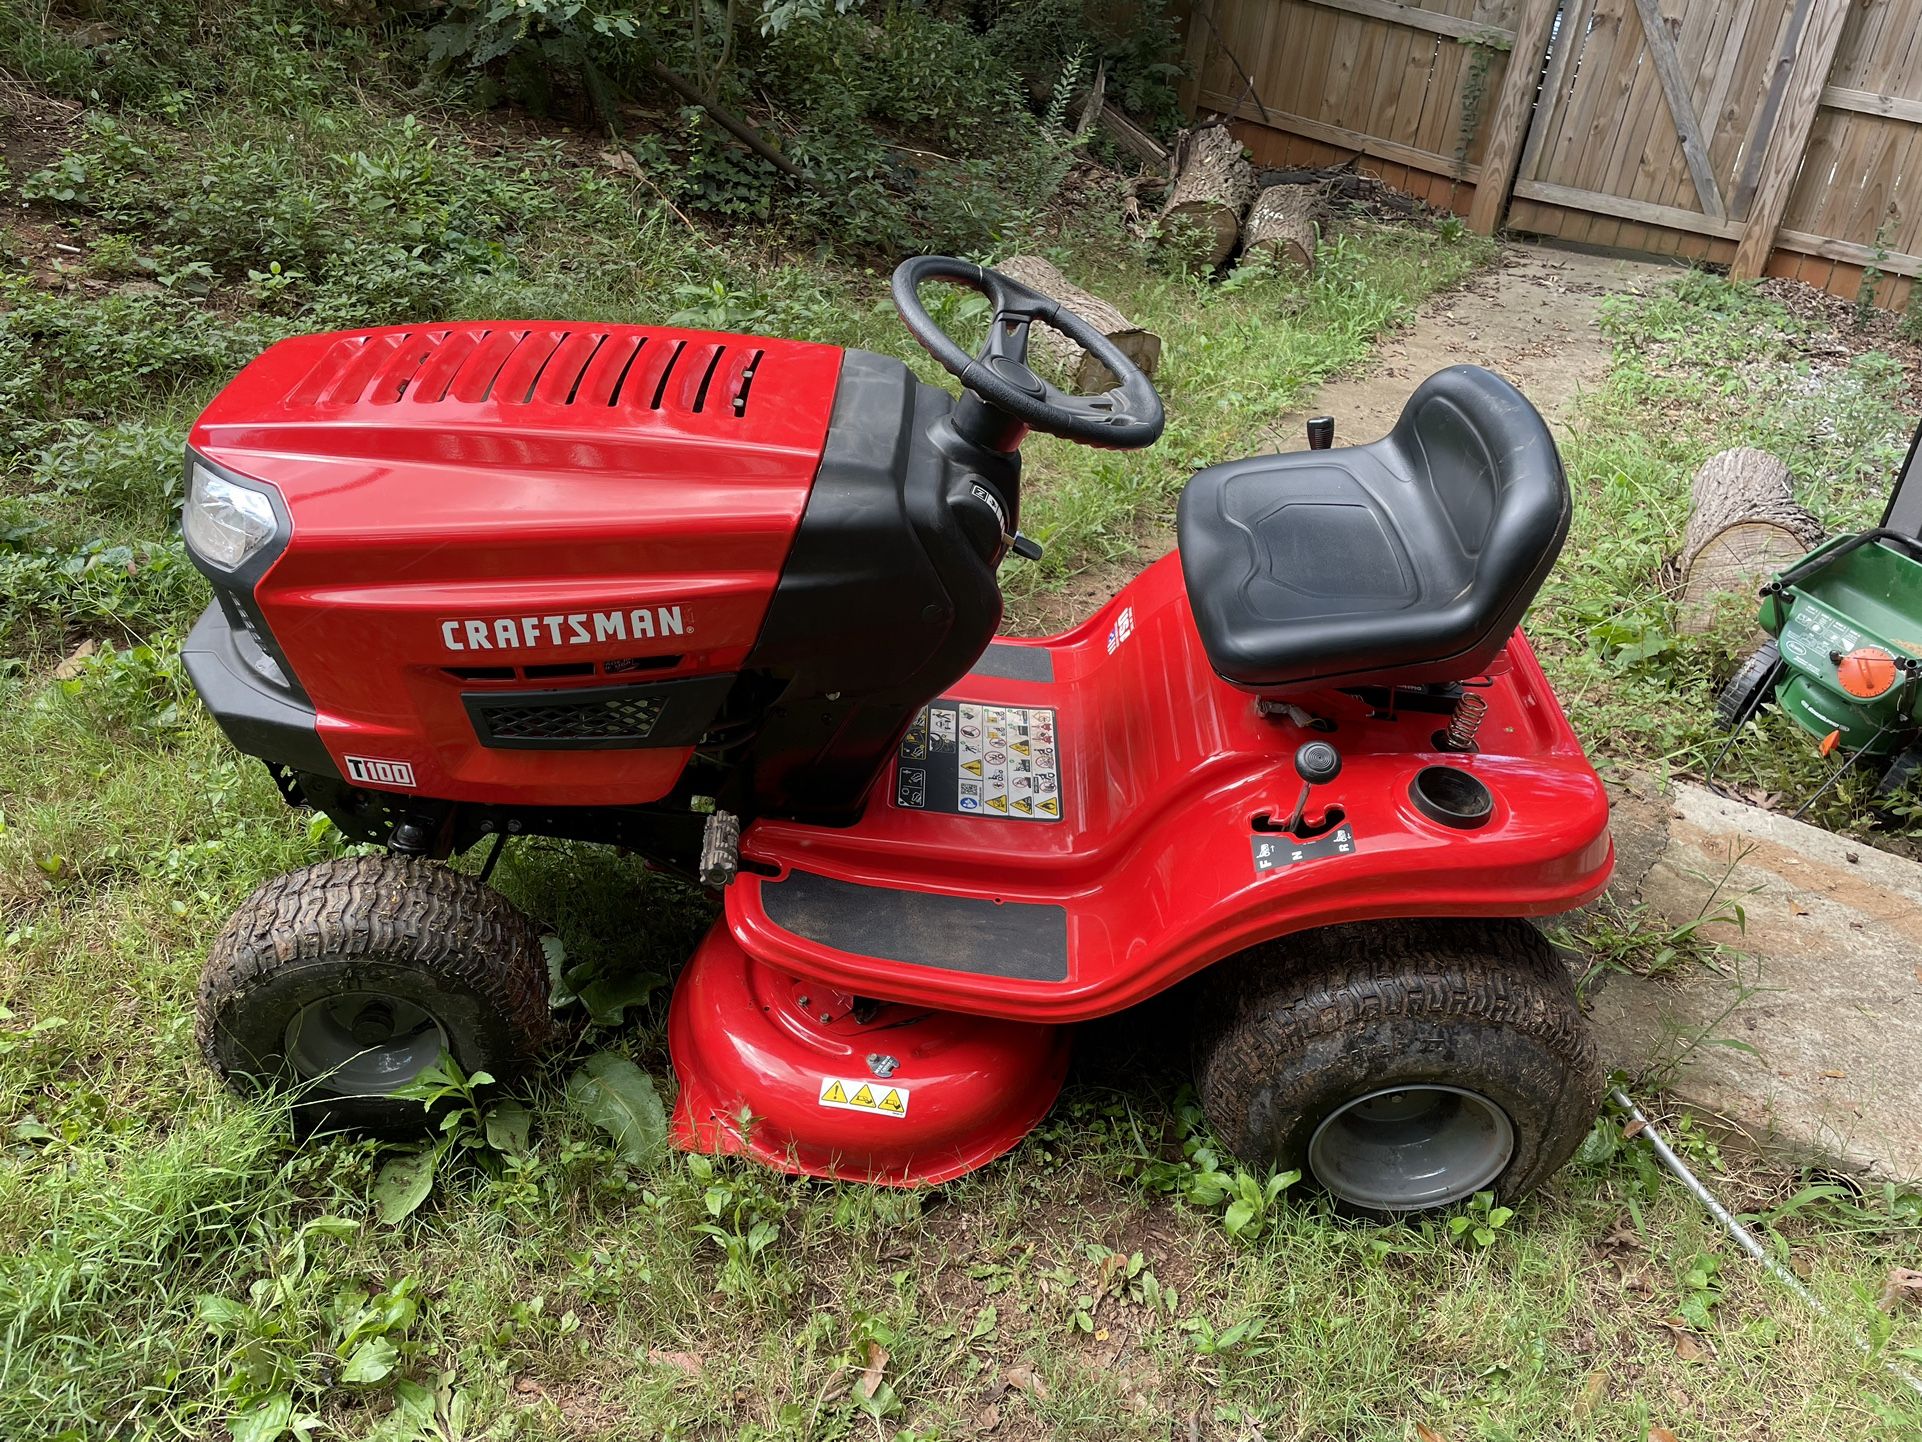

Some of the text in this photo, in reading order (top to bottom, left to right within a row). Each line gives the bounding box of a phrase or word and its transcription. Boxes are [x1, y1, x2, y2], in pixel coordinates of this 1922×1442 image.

[441, 606, 684, 650] CRAFTSMAN
[347, 759, 411, 784] T100
[1338, 843, 1350, 852] R
[1259, 860, 1272, 869] F
